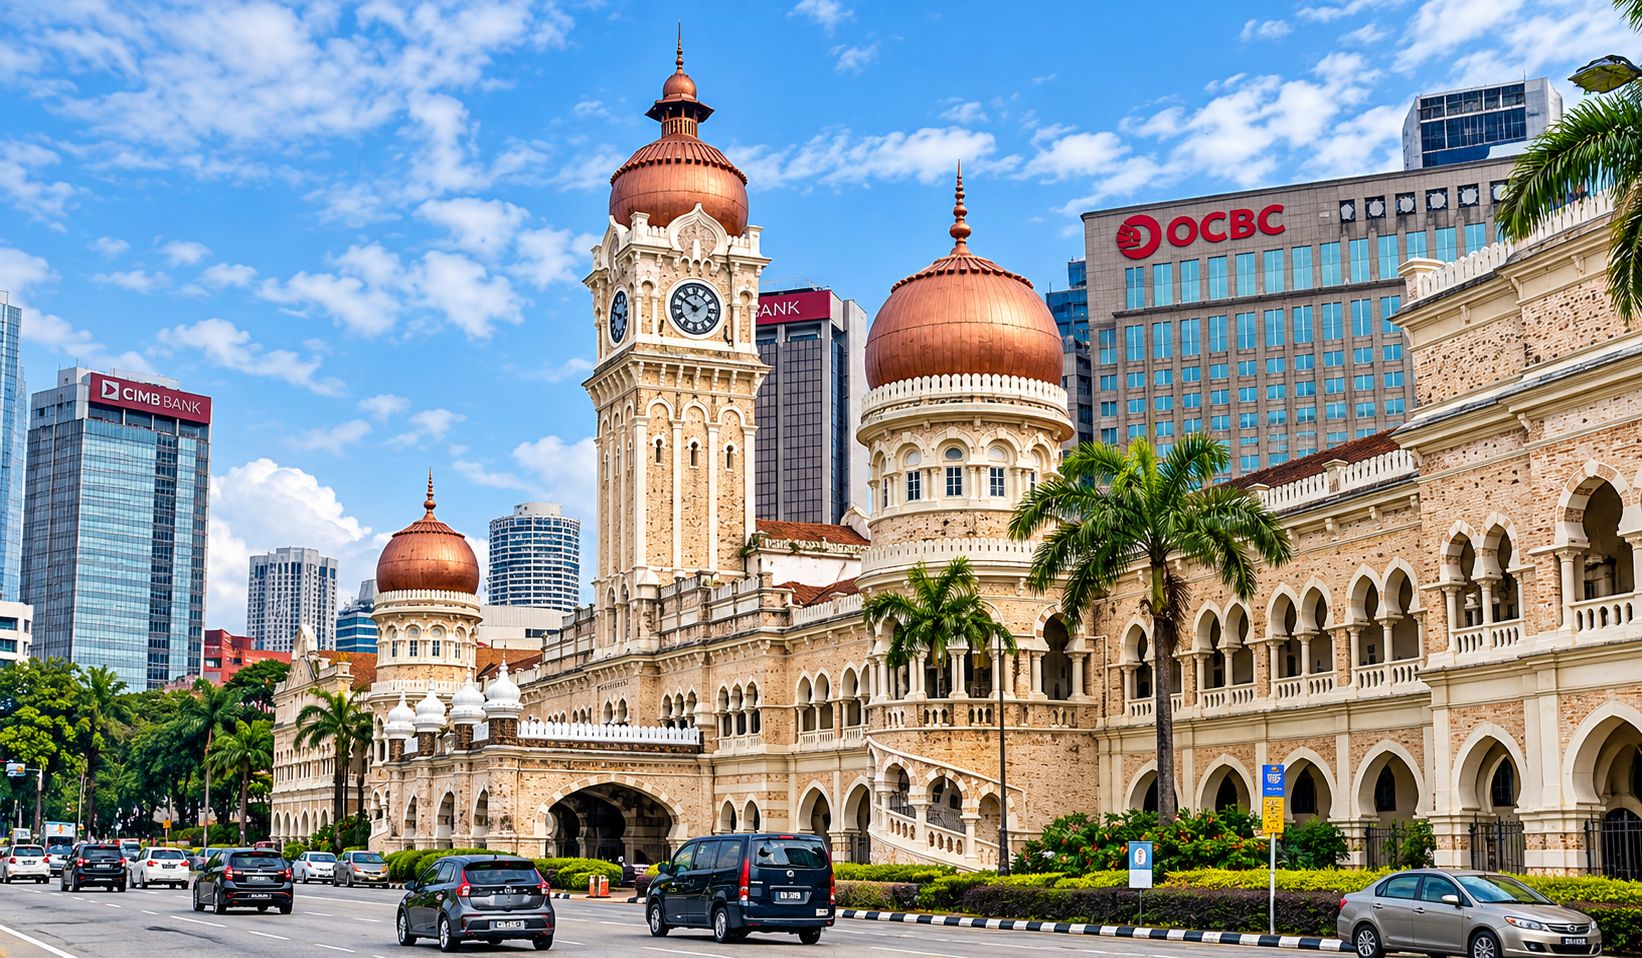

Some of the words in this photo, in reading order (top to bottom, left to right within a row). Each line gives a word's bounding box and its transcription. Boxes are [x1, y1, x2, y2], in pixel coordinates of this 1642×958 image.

[1166, 204, 1286, 247] OCBC
[756, 300, 800, 318] ANK
[122, 387, 161, 406] CIMB
[163, 395, 201, 415] BANK
